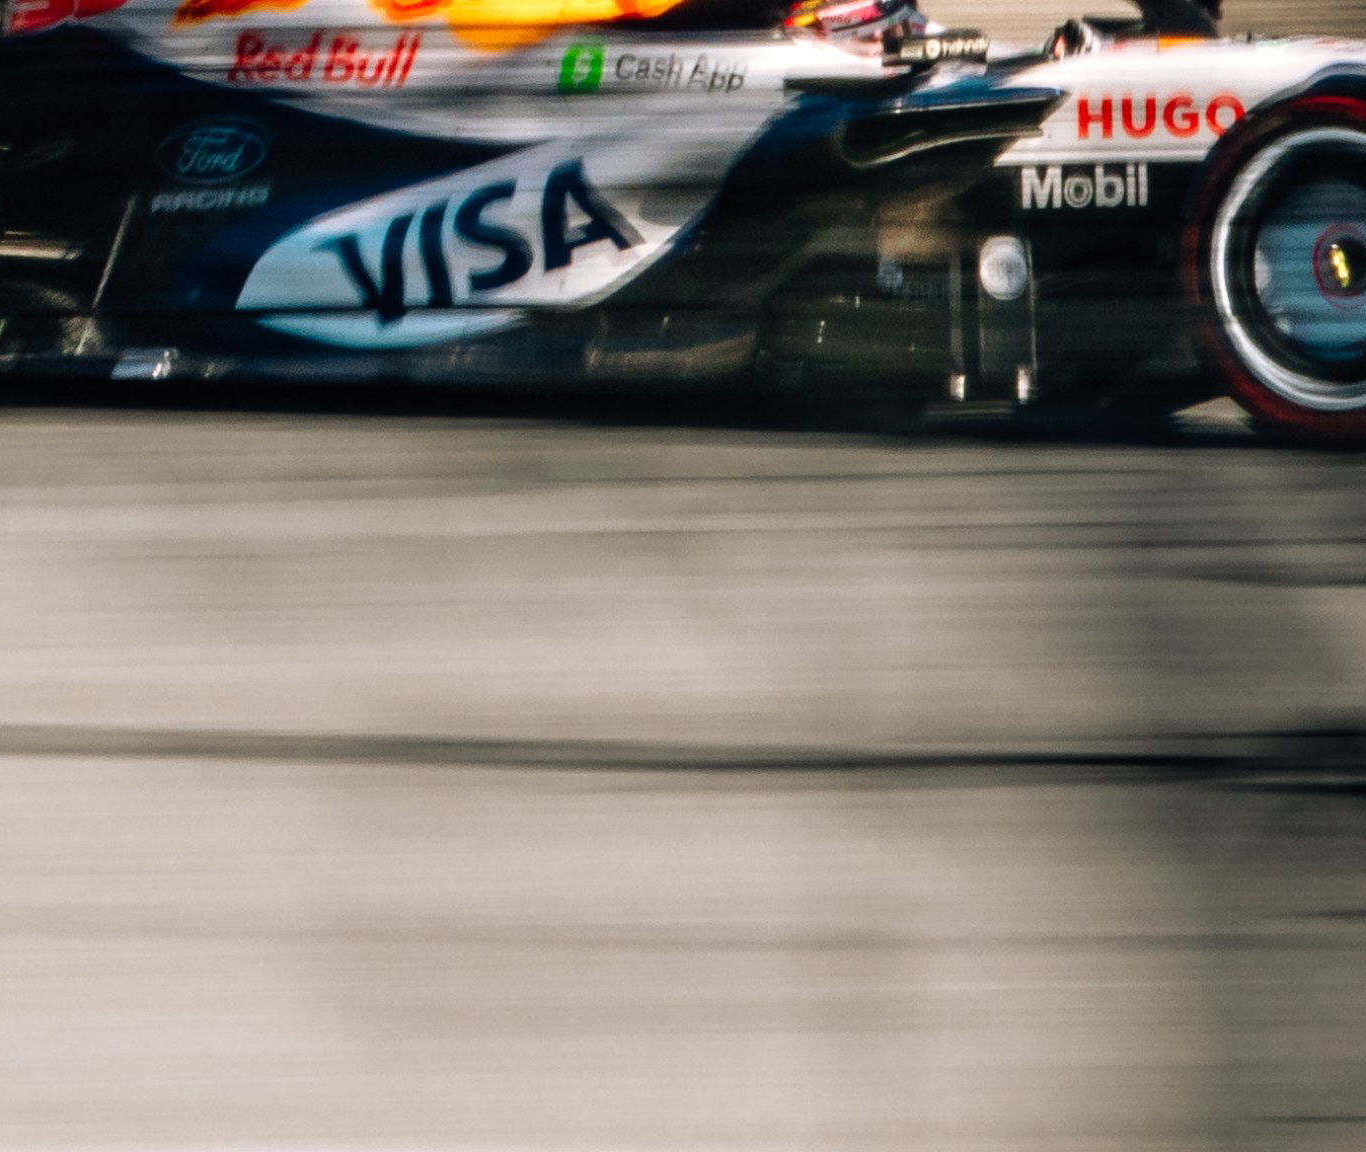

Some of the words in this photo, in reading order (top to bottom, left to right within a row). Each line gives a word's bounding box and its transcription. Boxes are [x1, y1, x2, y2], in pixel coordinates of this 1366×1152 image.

[227, 29, 321, 83] Red
[323, 32, 423, 88] Bull
[615, 52, 683, 86] Cash
[689, 53, 746, 94] App
[1077, 94, 1246, 140] HUGO
[176, 126, 253, 173] Ford
[1021, 164, 1149, 210] Mobil
[317, 157, 647, 327] VISA
